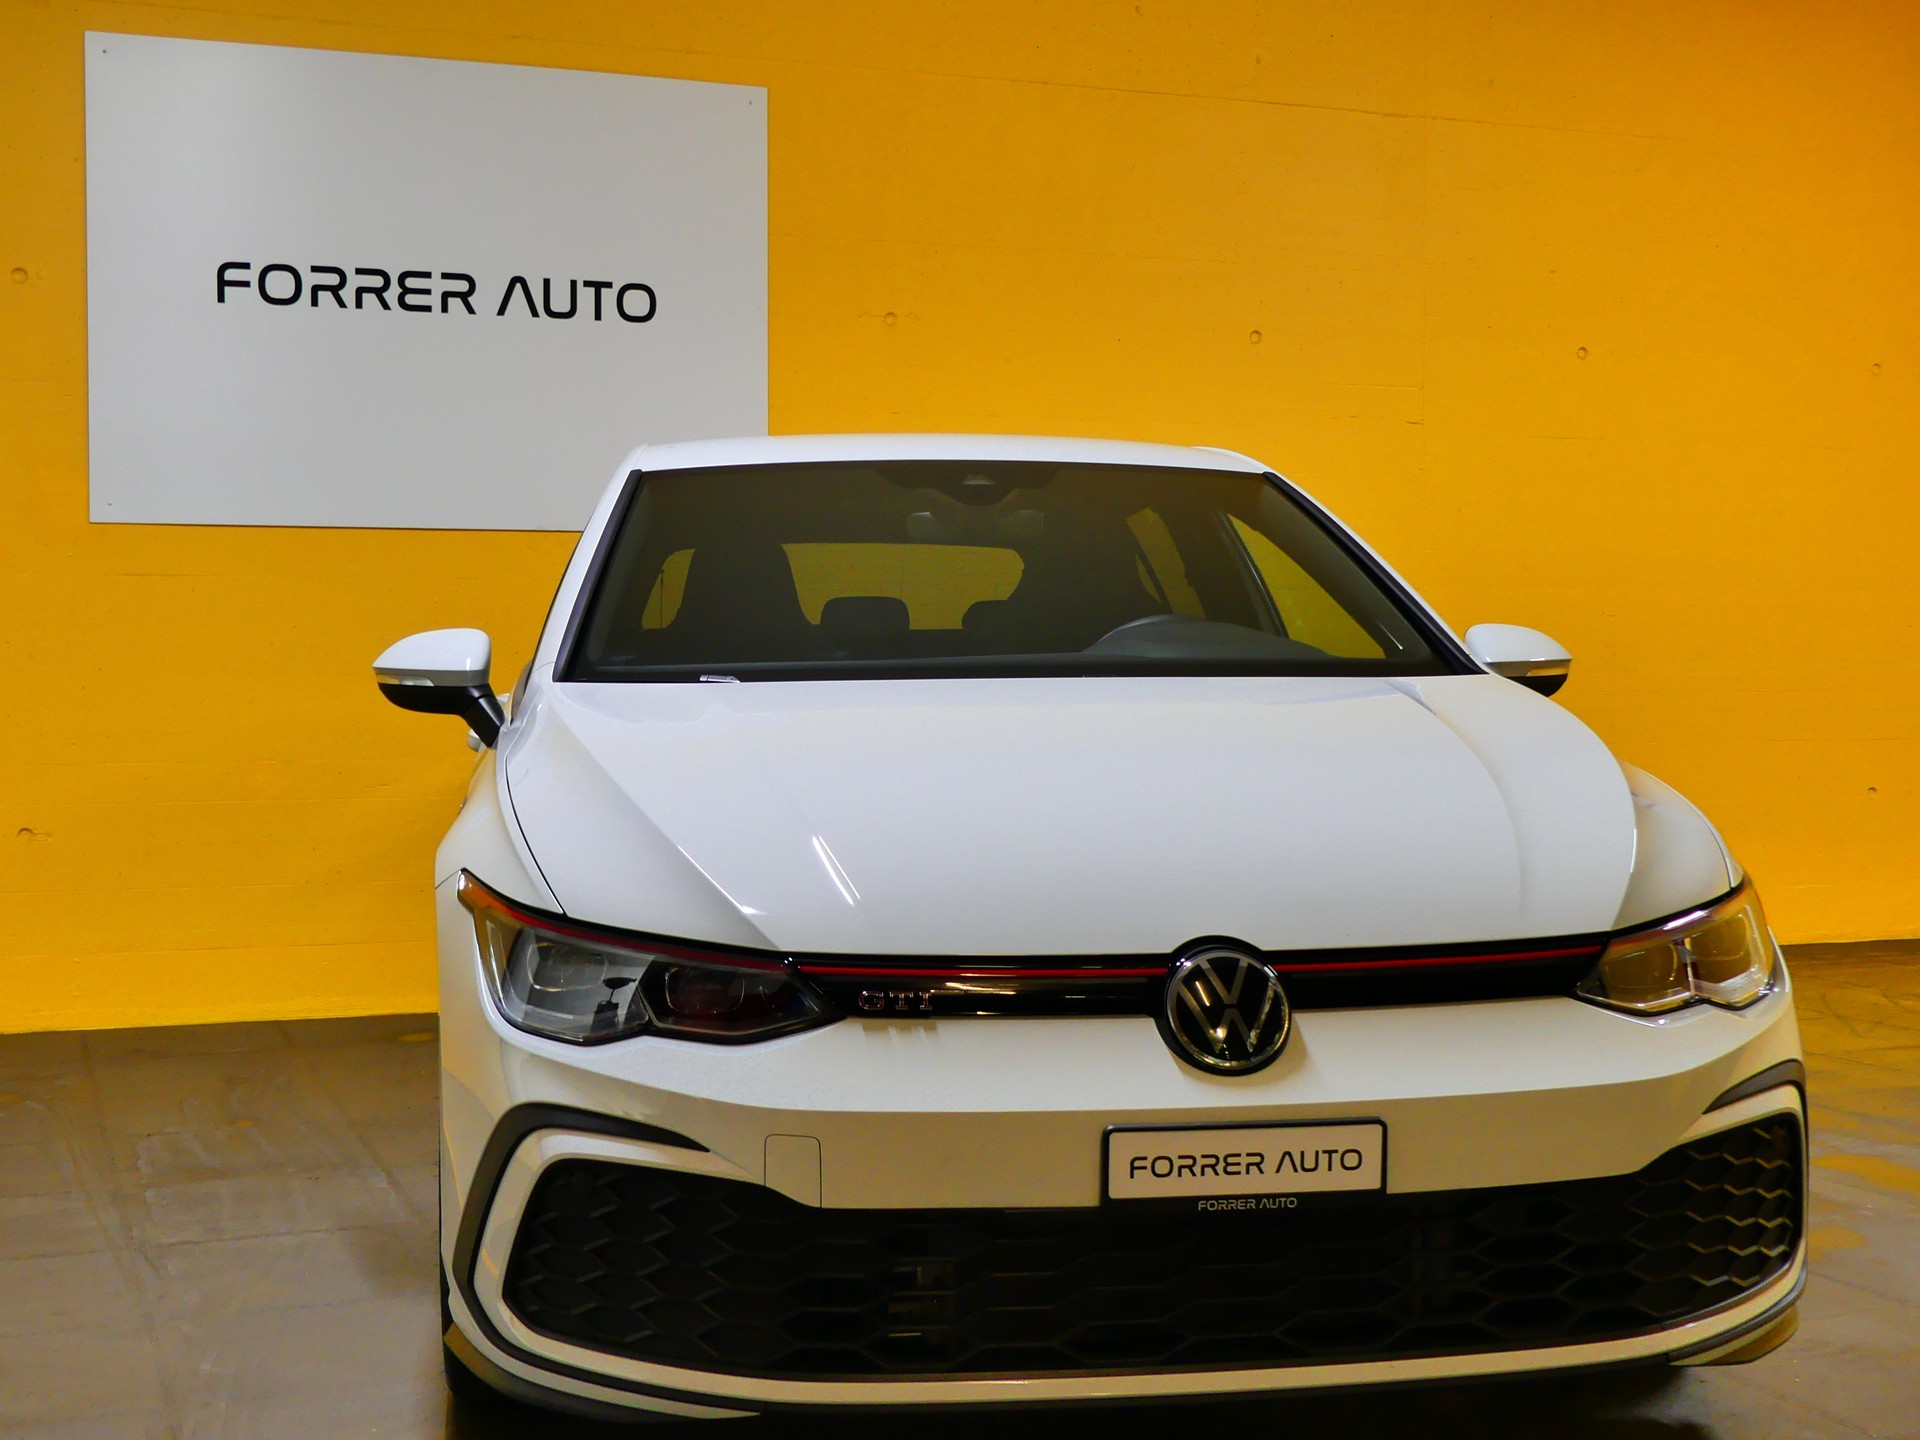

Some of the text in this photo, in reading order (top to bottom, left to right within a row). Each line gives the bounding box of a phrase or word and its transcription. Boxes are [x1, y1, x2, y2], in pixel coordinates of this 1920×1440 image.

[217, 262, 657, 323] FORRER AUTO
[859, 990, 934, 1011] GTI
[1130, 1149, 1363, 1179] FORRER AUTO
[1198, 1197, 1298, 1211] FORRER AUTO
